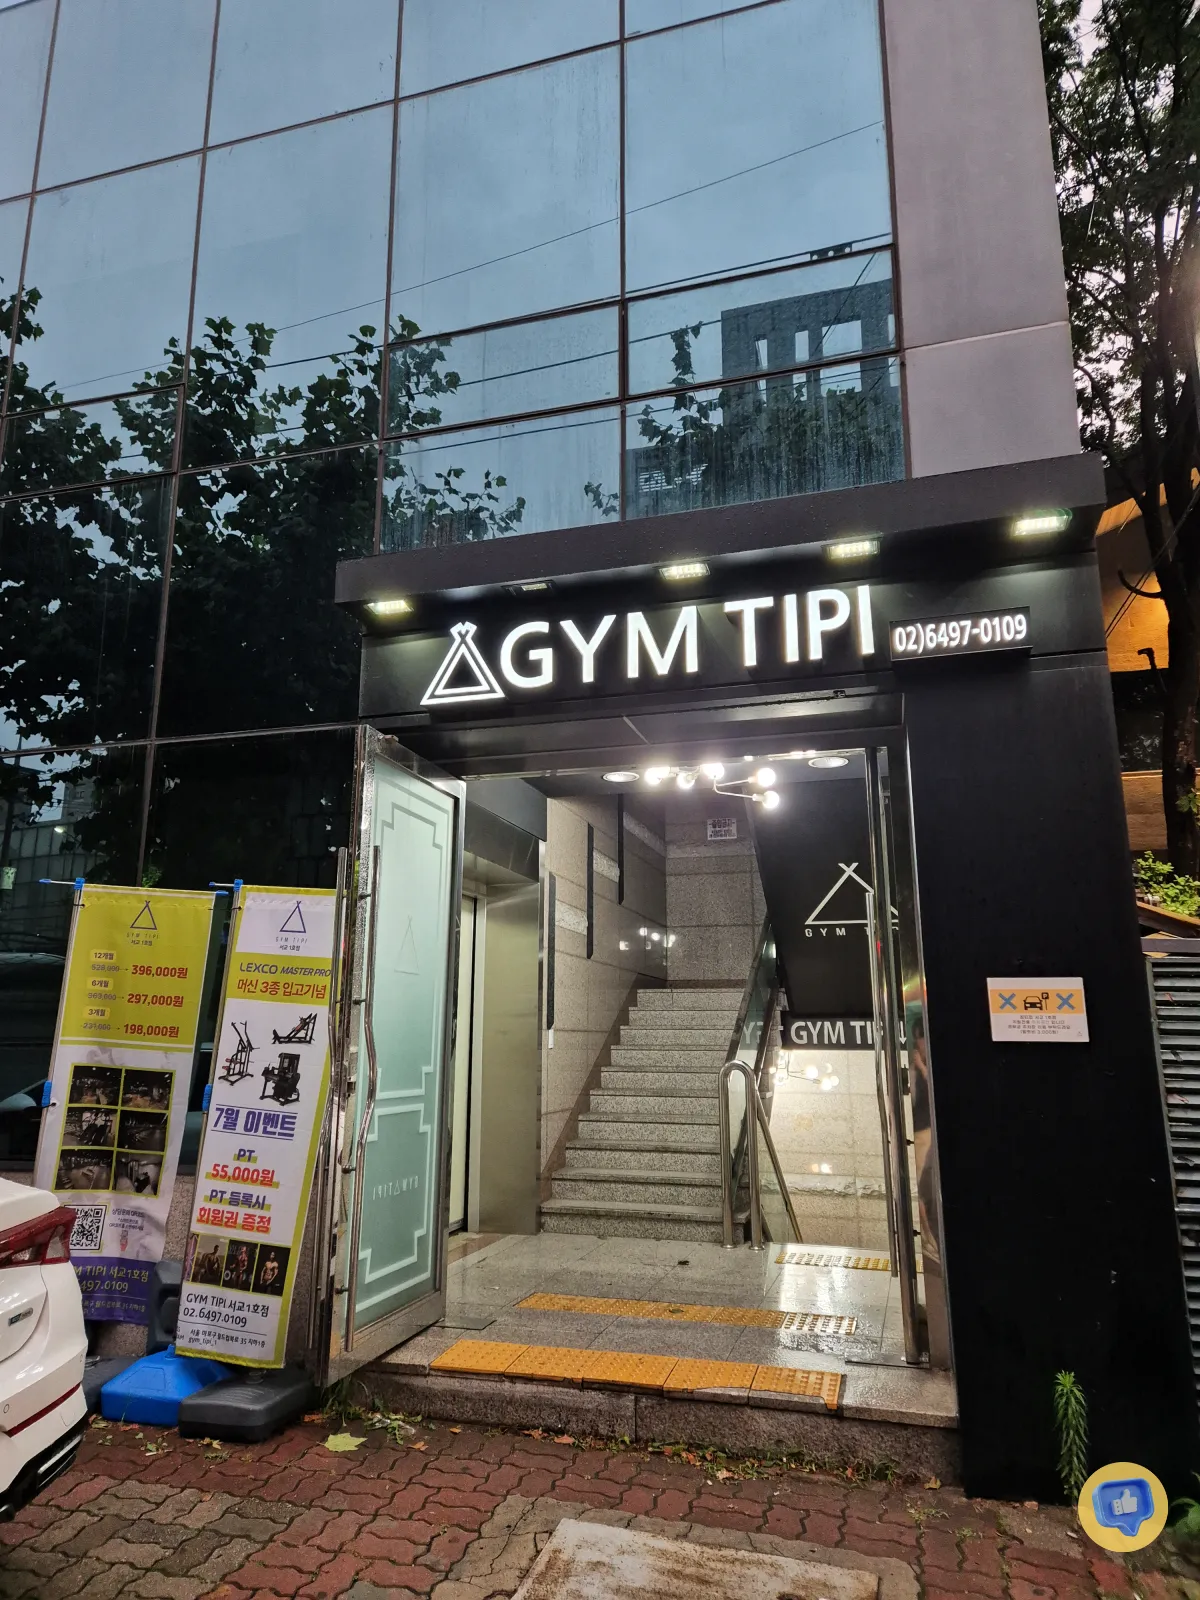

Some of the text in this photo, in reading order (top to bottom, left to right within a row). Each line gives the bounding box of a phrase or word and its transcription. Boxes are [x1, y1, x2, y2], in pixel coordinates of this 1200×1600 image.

[500, 584, 875, 688] GYM TIPI
[893, 613, 1028, 655] 02)6497-0109
[805, 928, 846, 937] GYM
[94, 952, 114, 960] 12개월
[131, 964, 188, 979] 396,000원
[239, 962, 278, 975] LEXCO
[91, 980, 109, 988] 6개월
[237, 978, 326, 999] 머신 3종 입고기념
[127, 993, 184, 1008] 297,000원
[88, 1009, 106, 1017] 3개월
[123, 1023, 180, 1038] 198,000원
[790, 1020, 846, 1045] GYM
[213, 1107, 297, 1138] 7월 이벤트
[237, 1148, 255, 1162] PT
[211, 1163, 275, 1187] 55,000원
[209, 1189, 266, 1210] PT 등록시
[197, 1206, 272, 1235] 회원권 증정
[86, 1265, 107, 1276] TIPI
[109, 1266, 149, 1283] 서교1호점
[80, 1280, 129, 1293] 497.0109
[186, 1293, 270, 1318] GYM TIPI 서교1호점
[183, 1307, 248, 1328] 02.6497.0109
[190, 1328, 200, 1337] 서울
